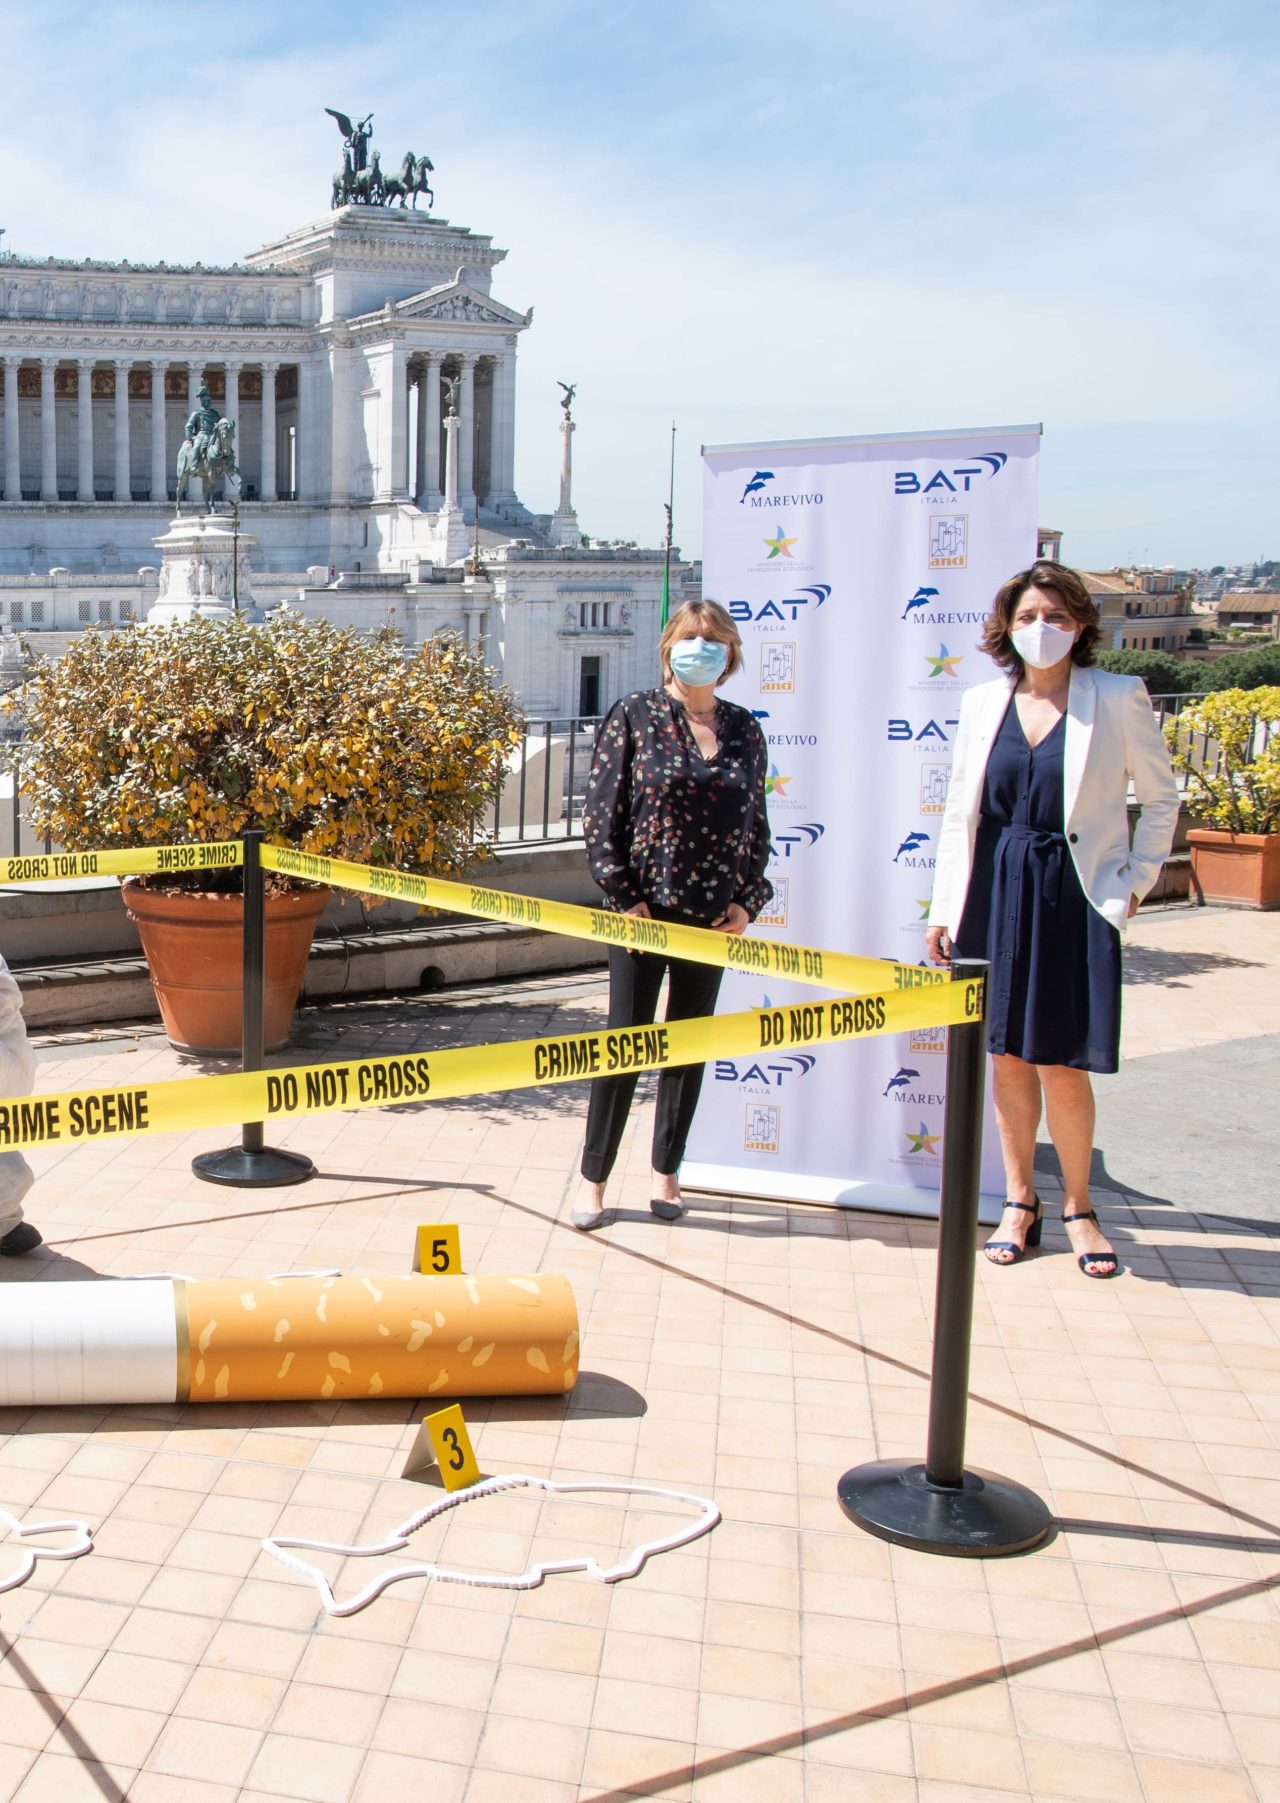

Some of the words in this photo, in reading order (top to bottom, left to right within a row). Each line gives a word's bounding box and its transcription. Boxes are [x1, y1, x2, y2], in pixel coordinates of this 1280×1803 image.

[894, 468, 982, 495] BAT
[751, 493, 823, 507] MAREVIVO
[920, 496, 957, 505] ITALIA
[930, 555, 964, 567] anci
[729, 599, 808, 622] BAT
[753, 624, 786, 632] ITALIA
[761, 680, 793, 691] anci
[767, 734, 818, 746] REVIVO
[913, 745, 949, 753] ITALIA
[759, 1011, 784, 1047] DO
[790, 1005, 824, 1043] NOT
[831, 996, 886, 1036] CROSS
[911, 1041, 945, 1051] anci
[533, 1041, 600, 1081] CRIME
[607, 1029, 669, 1071] SCENE
[715, 1060, 793, 1086] BAT
[267, 1072, 299, 1114] DO
[305, 1066, 348, 1108] NOT
[357, 1057, 430, 1103] CROSS
[738, 1086, 771, 1095] ITALIA
[894, 1092, 946, 1105] MAREV
[69, 1090, 150, 1136] SCENE
[745, 1140, 777, 1151] anci
[431, 1239, 450, 1272] 5
[442, 1427, 465, 1471] 3
